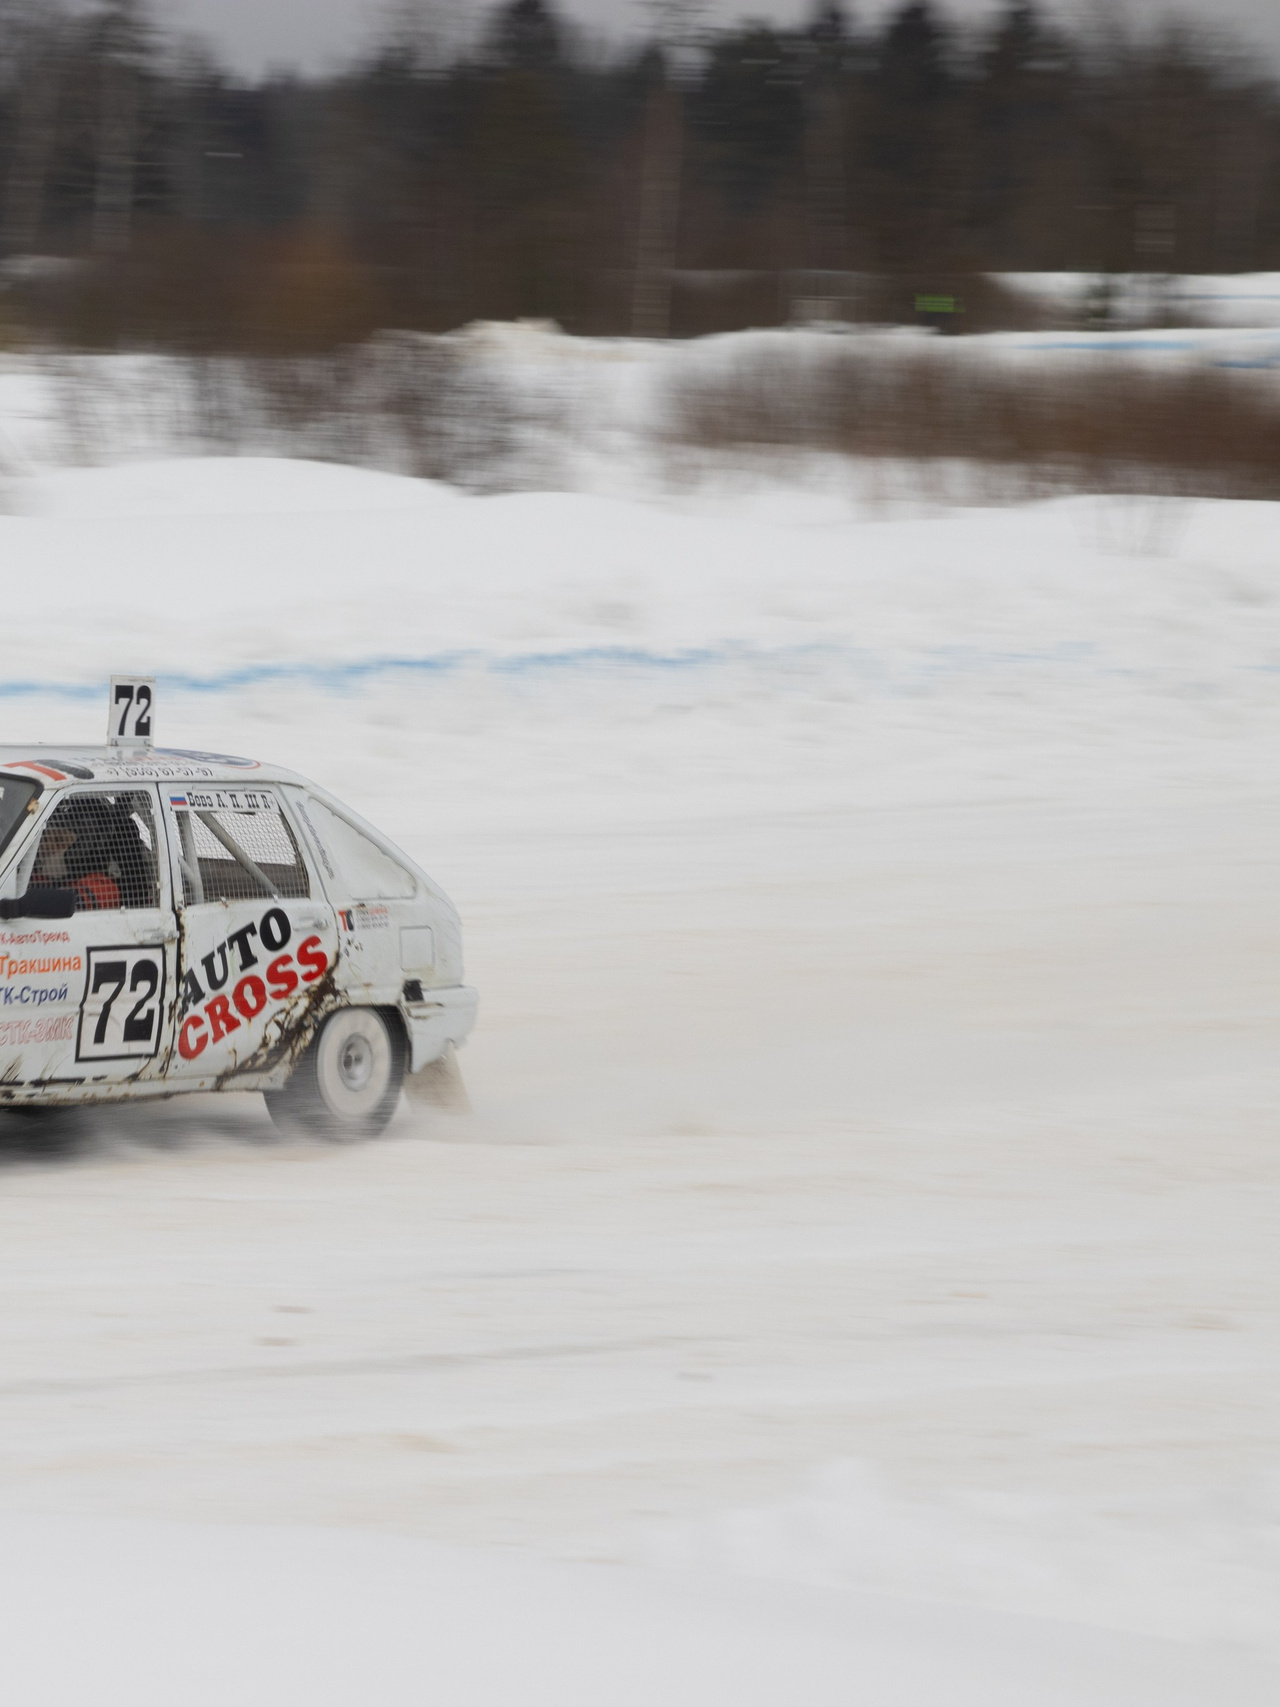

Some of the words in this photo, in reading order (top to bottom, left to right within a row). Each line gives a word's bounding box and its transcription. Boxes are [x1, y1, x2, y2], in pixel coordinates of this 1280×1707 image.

[115, 685, 151, 736] 72
[91, 959, 158, 1045] 72
[177, 907, 291, 1022] AUTO
[178, 935, 328, 1061] CROSS
